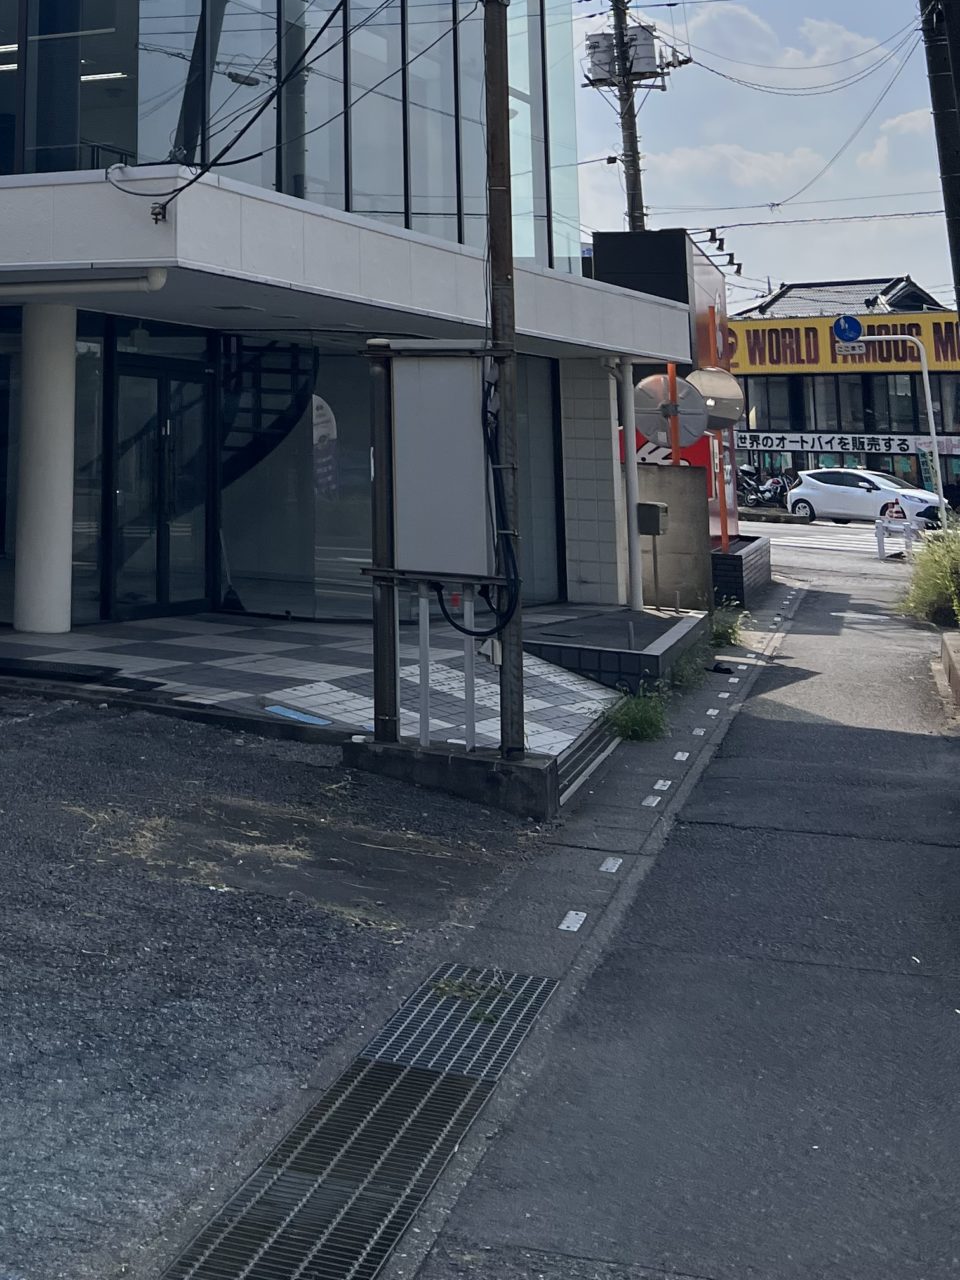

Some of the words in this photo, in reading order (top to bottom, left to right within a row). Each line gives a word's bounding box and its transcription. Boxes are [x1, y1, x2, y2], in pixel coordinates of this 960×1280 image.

[745, 327, 819, 365] WORLD
[829, 323, 922, 364] FMOUS
[932, 322, 960, 362] M
[736, 434, 910, 452] 世界のオートバイを販売する
